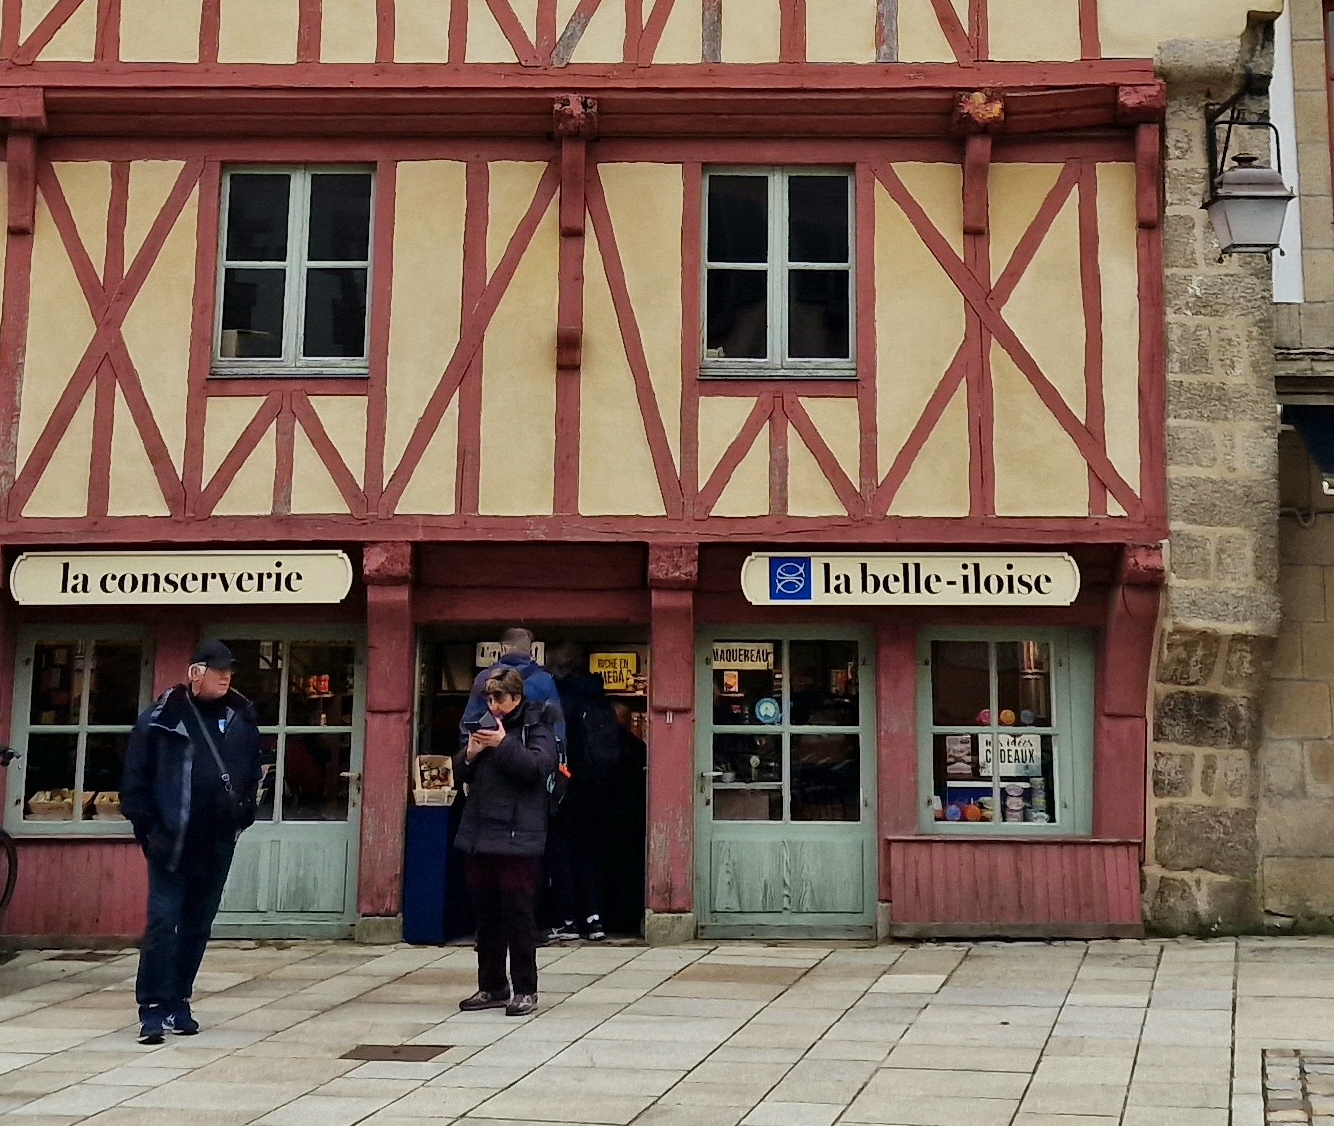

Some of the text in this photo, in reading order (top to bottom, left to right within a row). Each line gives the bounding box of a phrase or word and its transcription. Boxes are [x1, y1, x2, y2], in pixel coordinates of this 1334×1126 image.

[60, 560, 303, 594] la conserverie
[822, 562, 1053, 595] la belle-iloise
[985, 748, 1035, 764] CDEAUX
